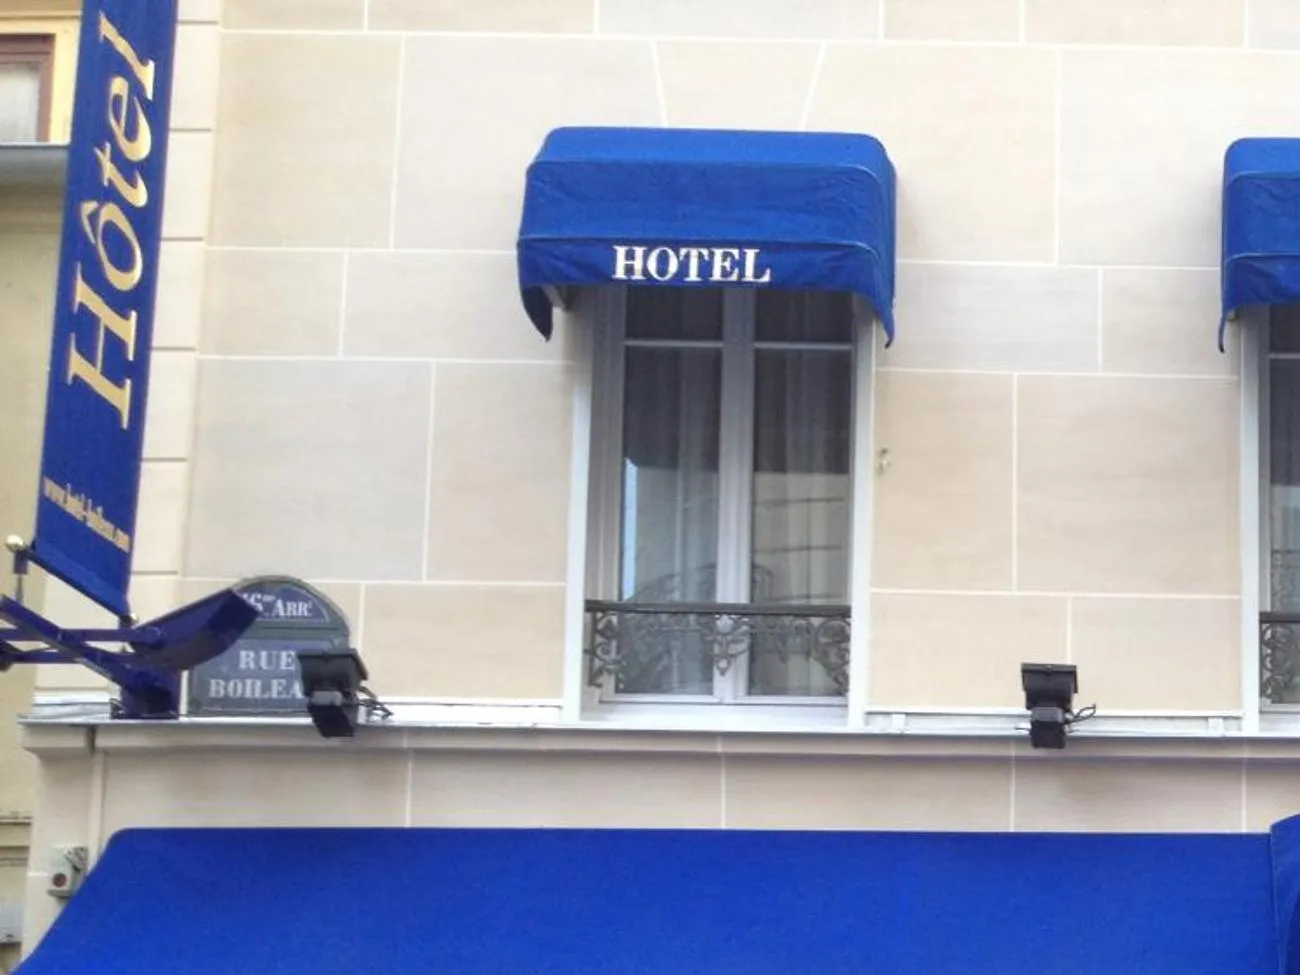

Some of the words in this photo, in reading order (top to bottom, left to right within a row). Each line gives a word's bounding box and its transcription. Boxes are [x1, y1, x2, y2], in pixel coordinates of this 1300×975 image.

[67, 13, 155, 430] Hôtel
[612, 245, 771, 282] HOTEL
[238, 650, 296, 670] RUE
[209, 678, 304, 699] BOILEA
